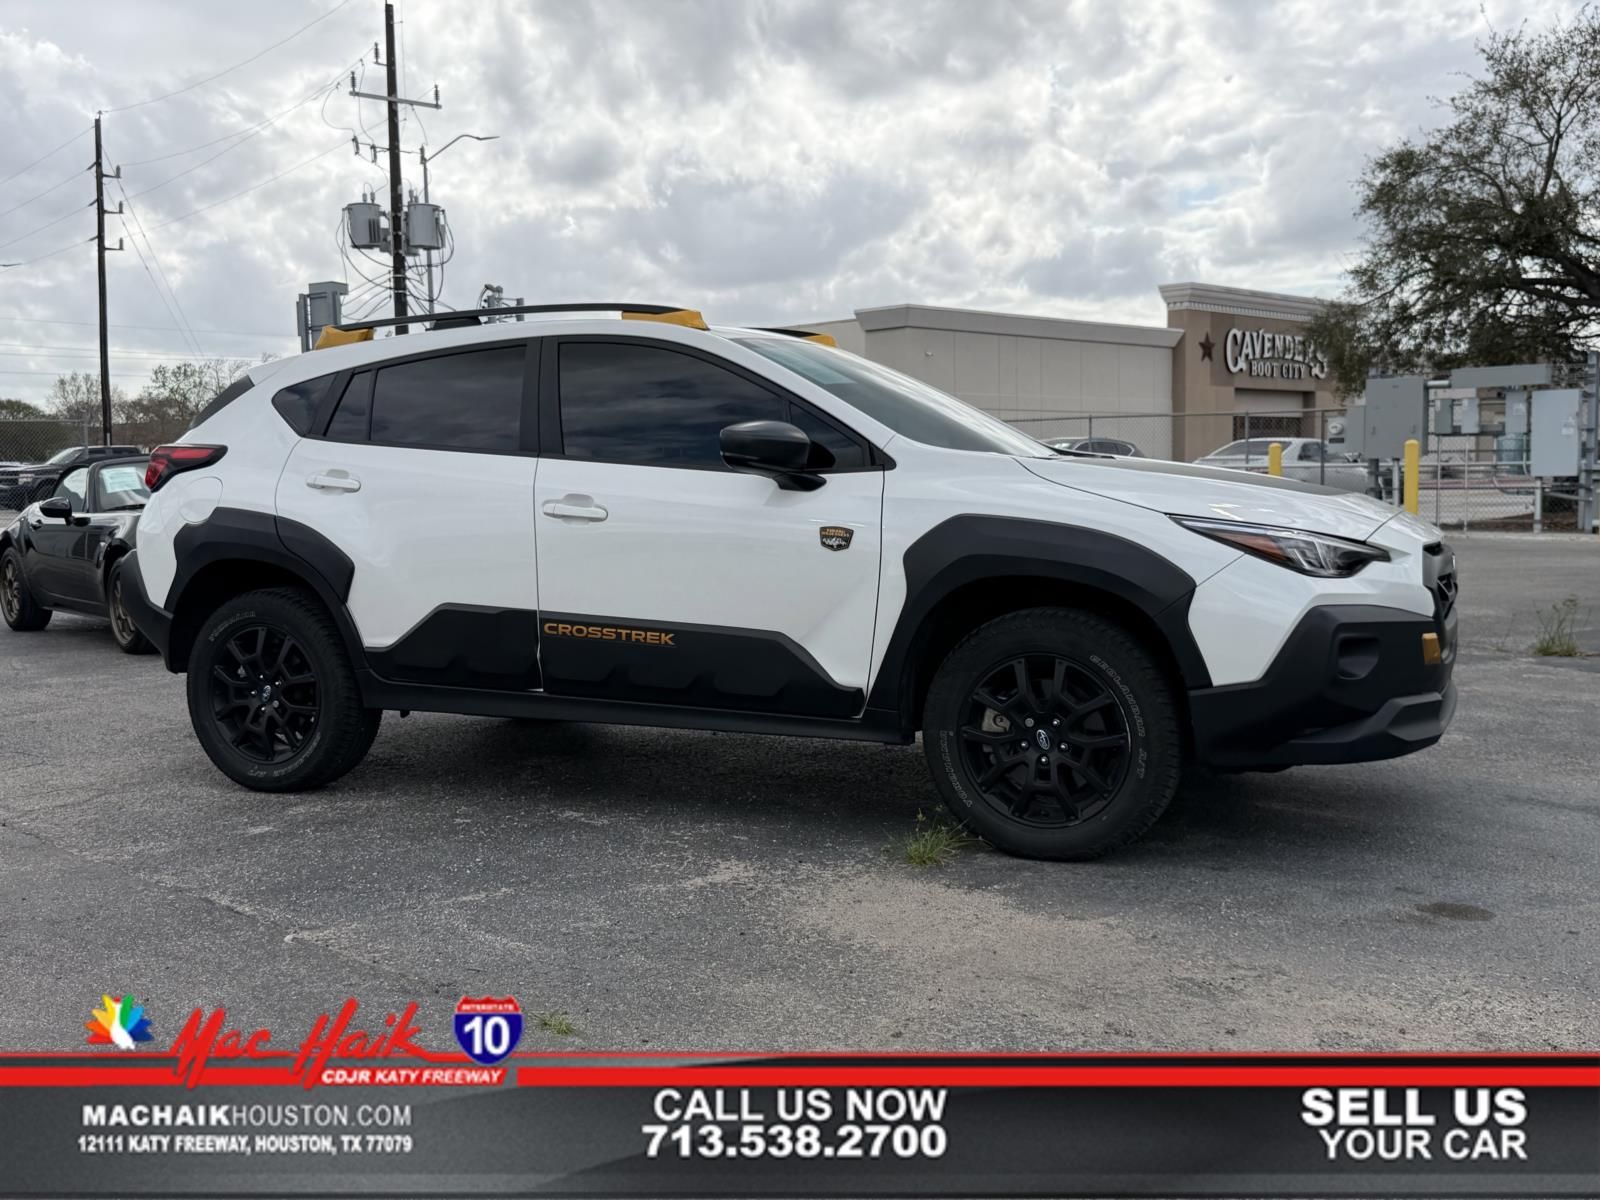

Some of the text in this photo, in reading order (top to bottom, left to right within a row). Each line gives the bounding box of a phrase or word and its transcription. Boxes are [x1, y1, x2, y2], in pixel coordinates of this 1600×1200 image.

[1251, 361, 1305, 379] BOOT CITY
[543, 623, 676, 646] CROSSTREK
